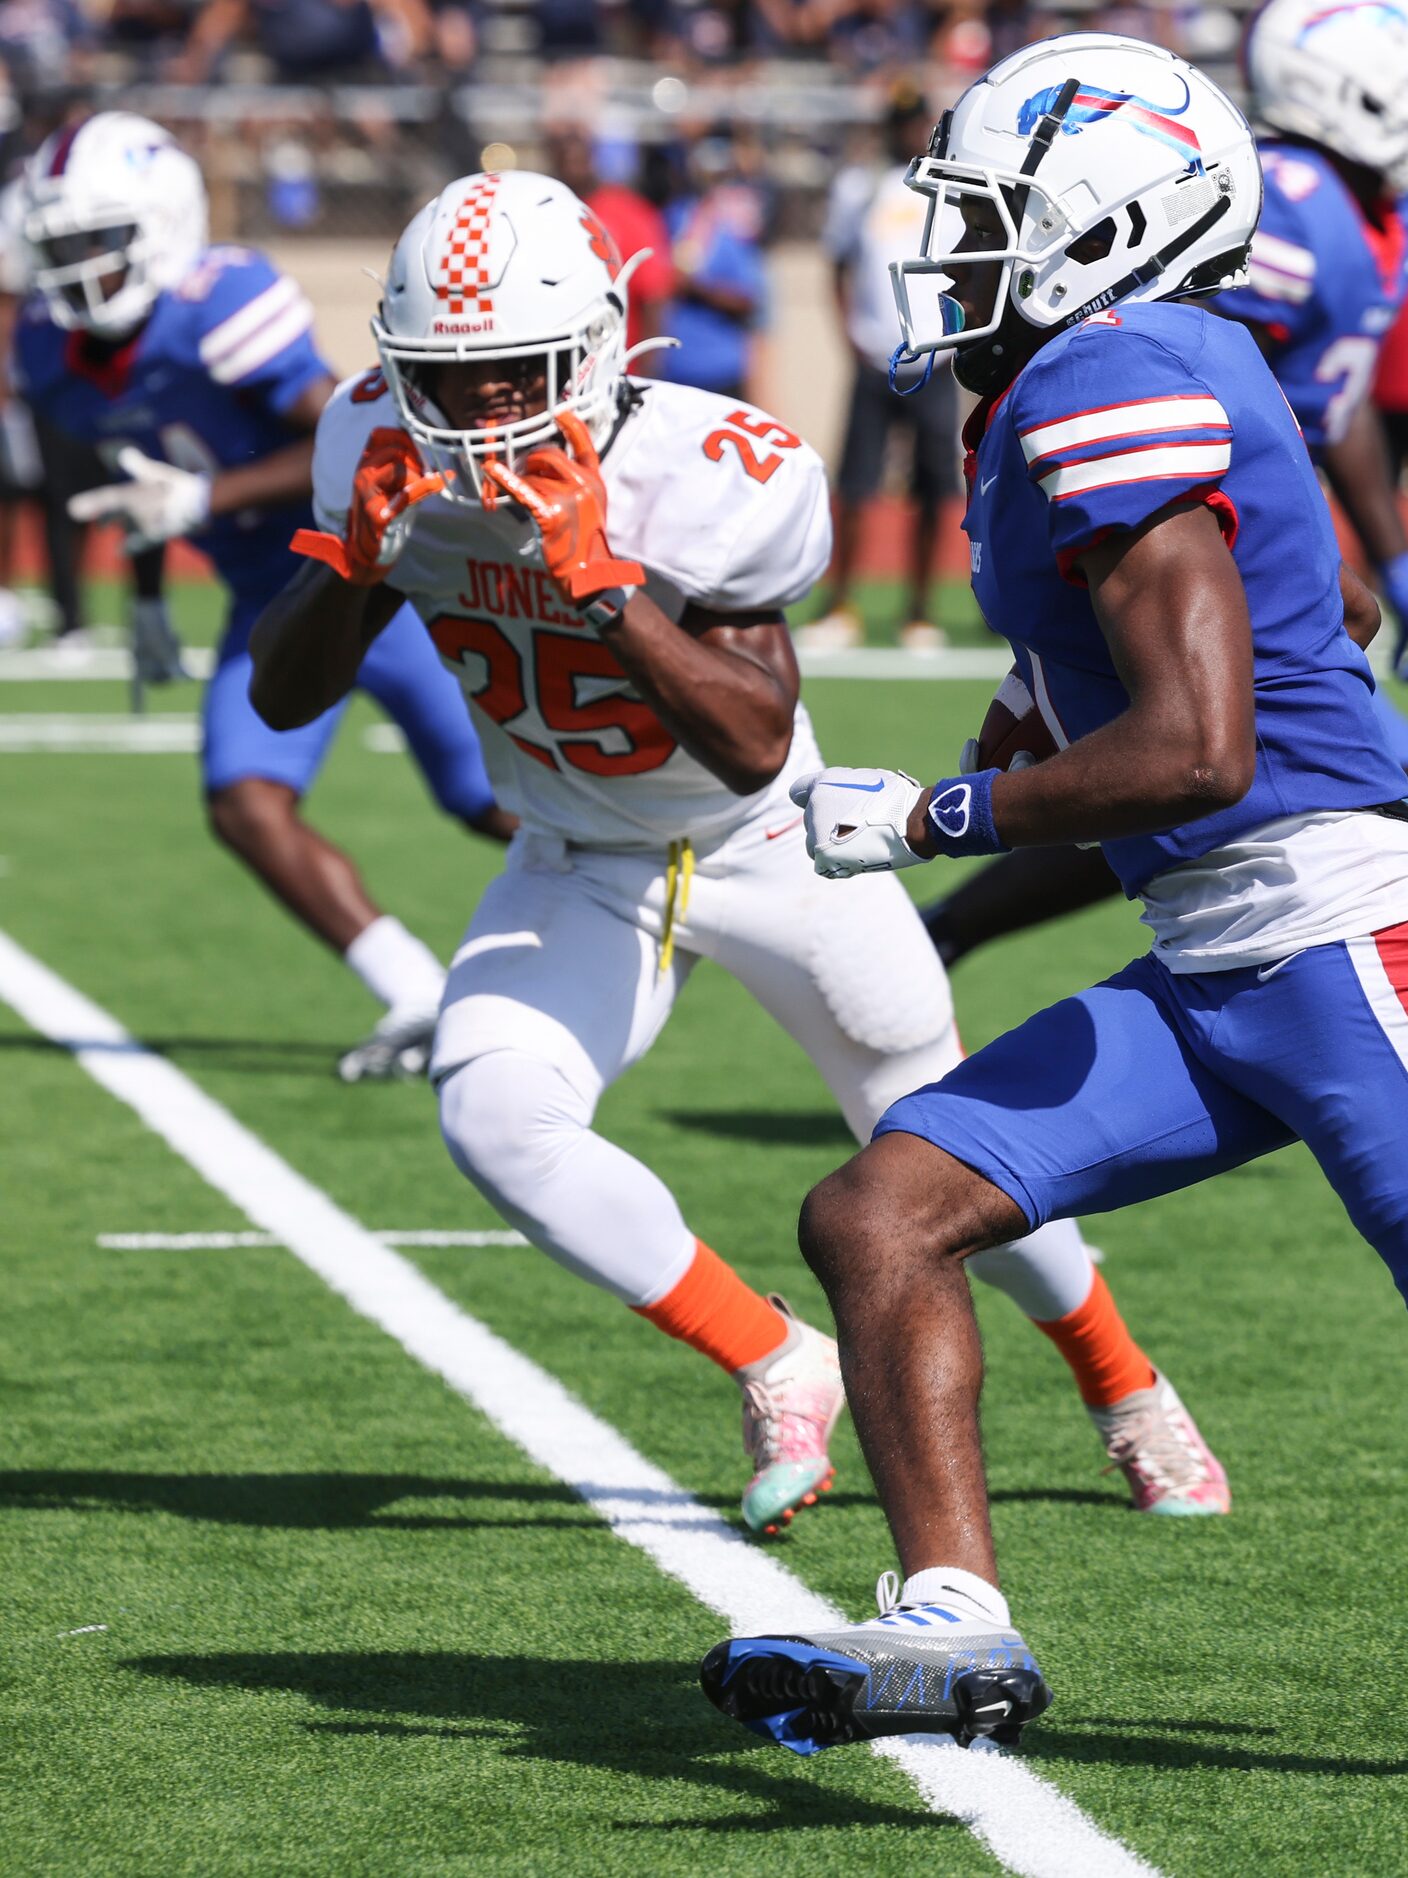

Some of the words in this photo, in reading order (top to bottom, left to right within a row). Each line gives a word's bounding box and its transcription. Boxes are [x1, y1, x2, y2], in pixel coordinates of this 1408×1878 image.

[1066, 288, 1118, 326] schutt
[702, 409, 802, 485] 25
[428, 613, 679, 777] 25
